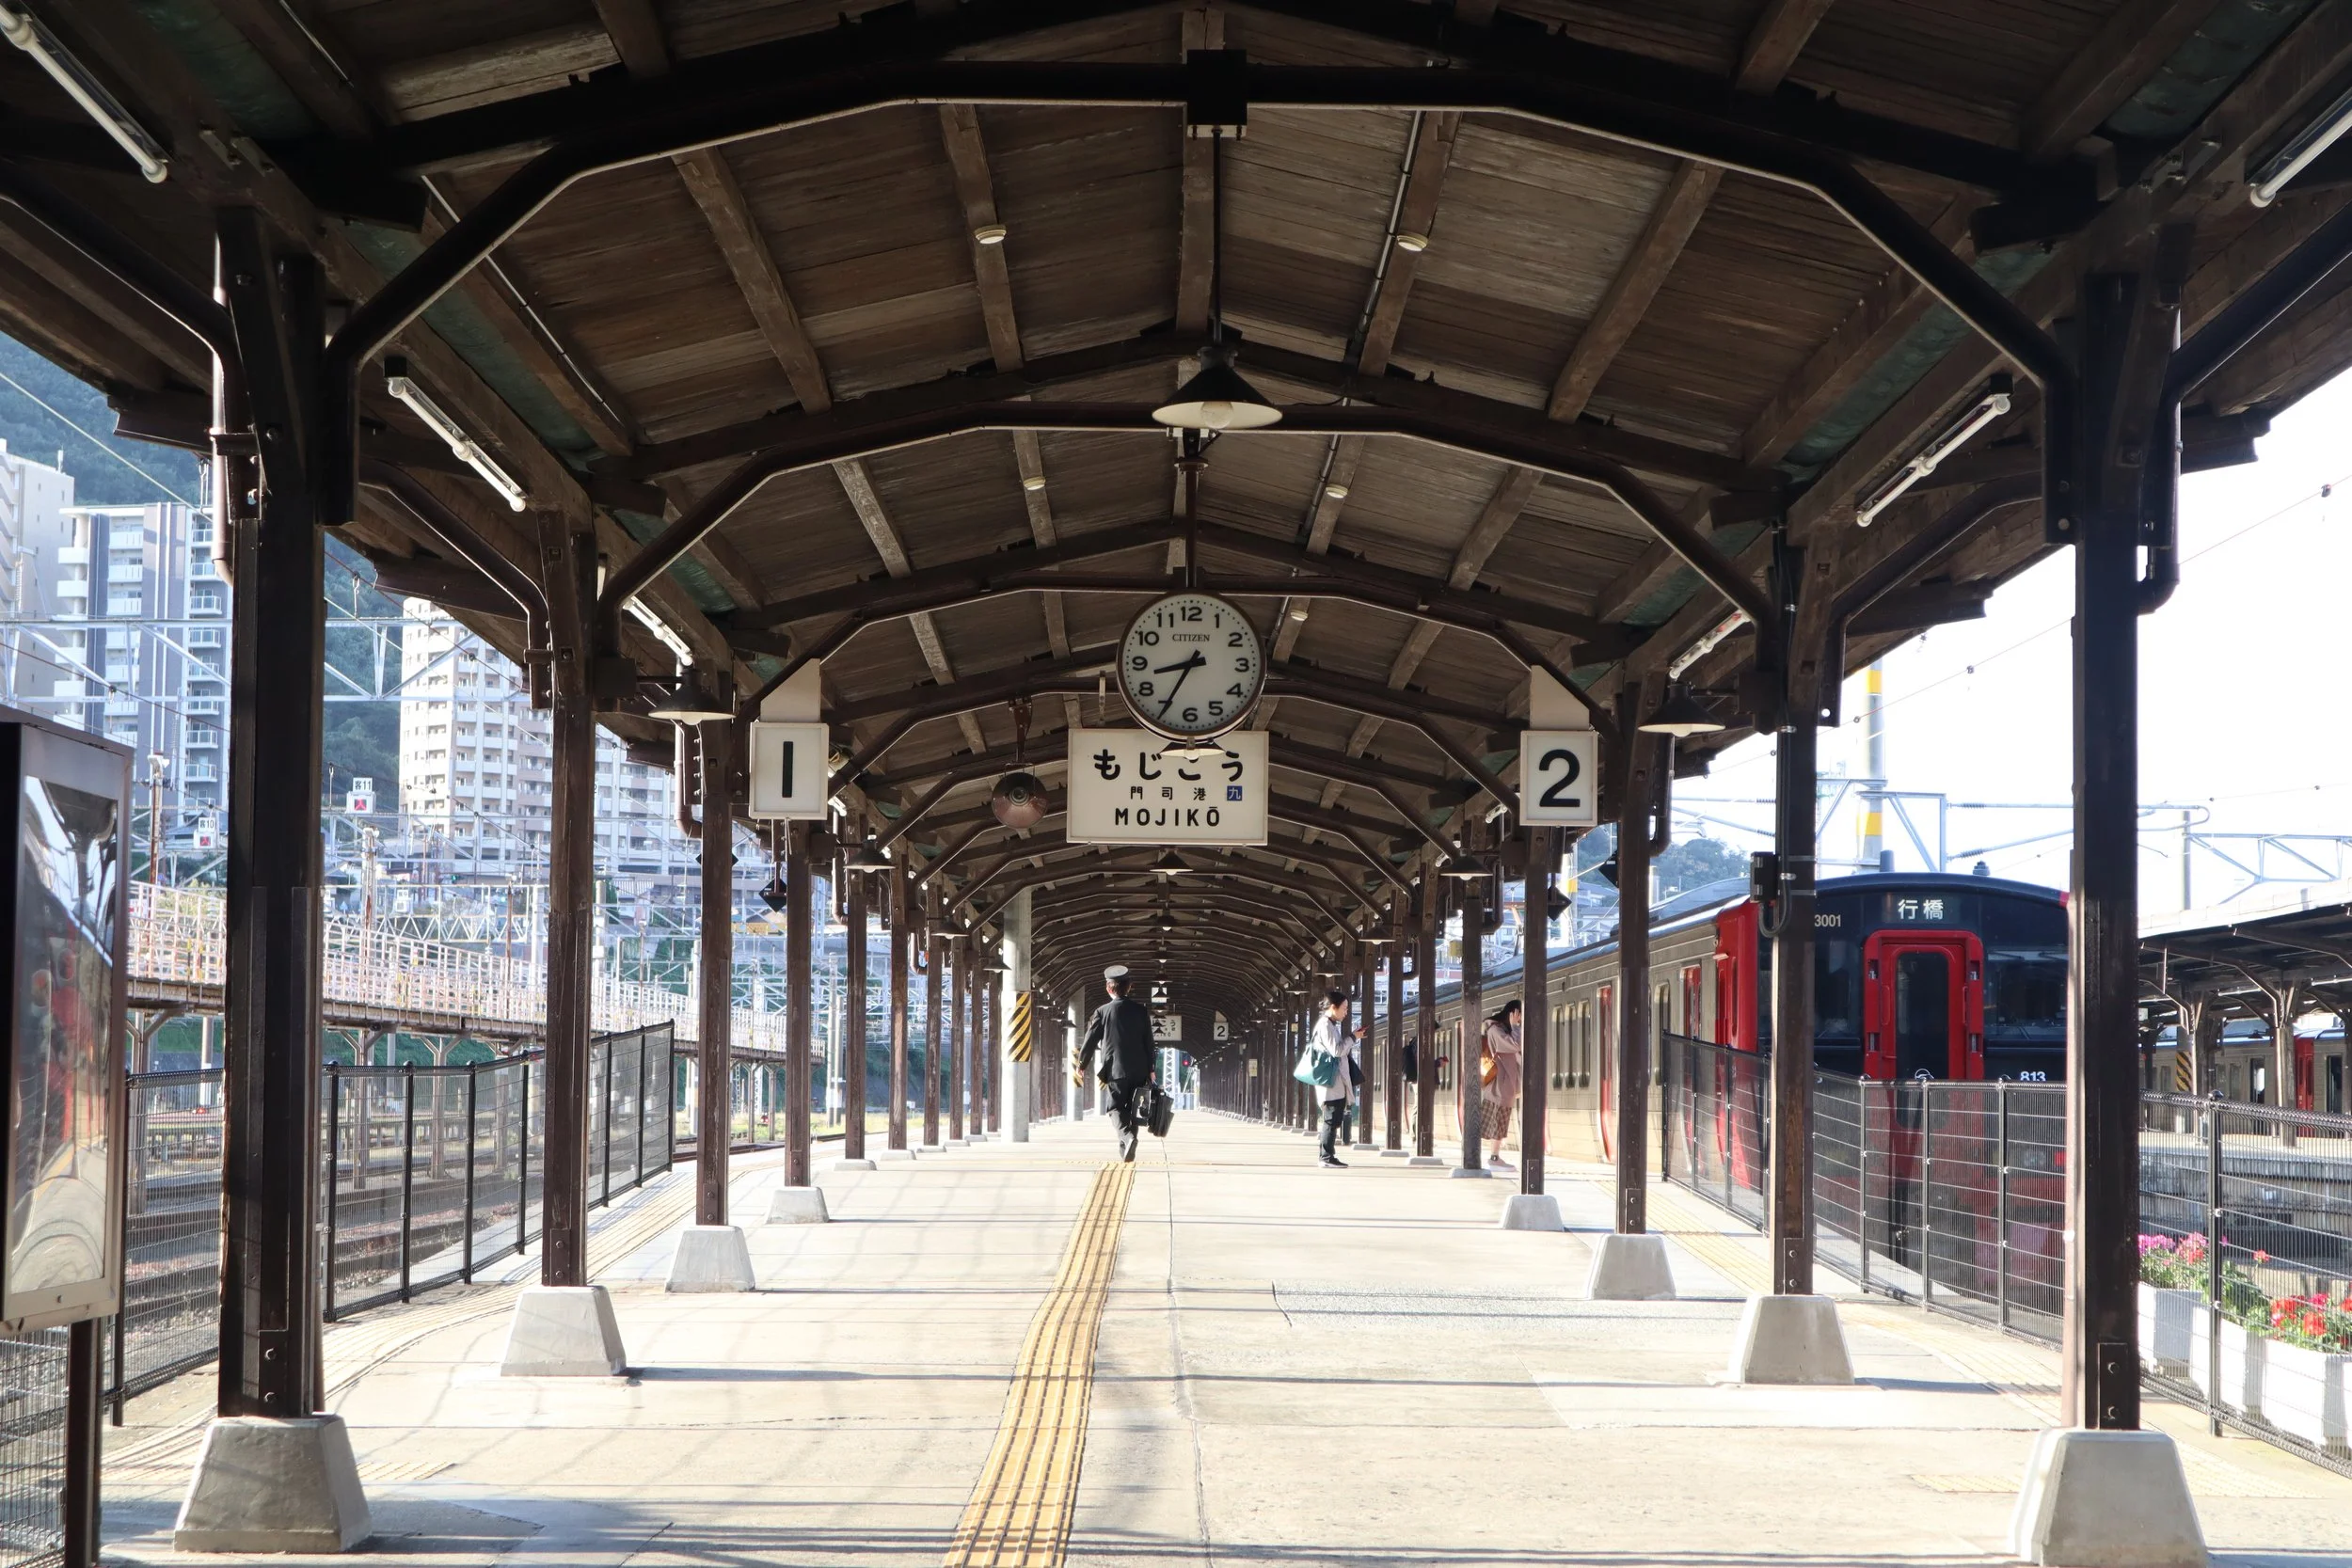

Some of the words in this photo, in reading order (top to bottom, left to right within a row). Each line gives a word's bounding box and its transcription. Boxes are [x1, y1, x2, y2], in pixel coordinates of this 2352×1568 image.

[1156, 612, 1174, 627] 11
[1180, 606, 1202, 622] 12
[1214, 612, 1220, 628] 1
[1137, 630, 1159, 646] 10
[1172, 633, 1210, 642] CITIZEN
[1228, 632, 1243, 647] 2
[1132, 656, 1148, 671] 9
[1234, 657, 1249, 673] 3
[1138, 681, 1154, 696] 8
[1226, 683, 1243, 698] 4
[1182, 707, 1198, 722] 6
[1208, 700, 1223, 716] 5
[782, 741, 793, 798] 1
[1093, 749, 1243, 782] もじこう
[1539, 749, 1580, 807] 2
[1130, 785, 1206, 801] 門司港
[1228, 786, 1242, 800] 九
[1115, 806, 1220, 827] MOJIKŌ
[1898, 898, 1944, 920] 行橋
[1814, 914, 1841, 927] 3001
[1217, 1025, 1225, 1037] 2
[2020, 1070, 2046, 1082] 813
